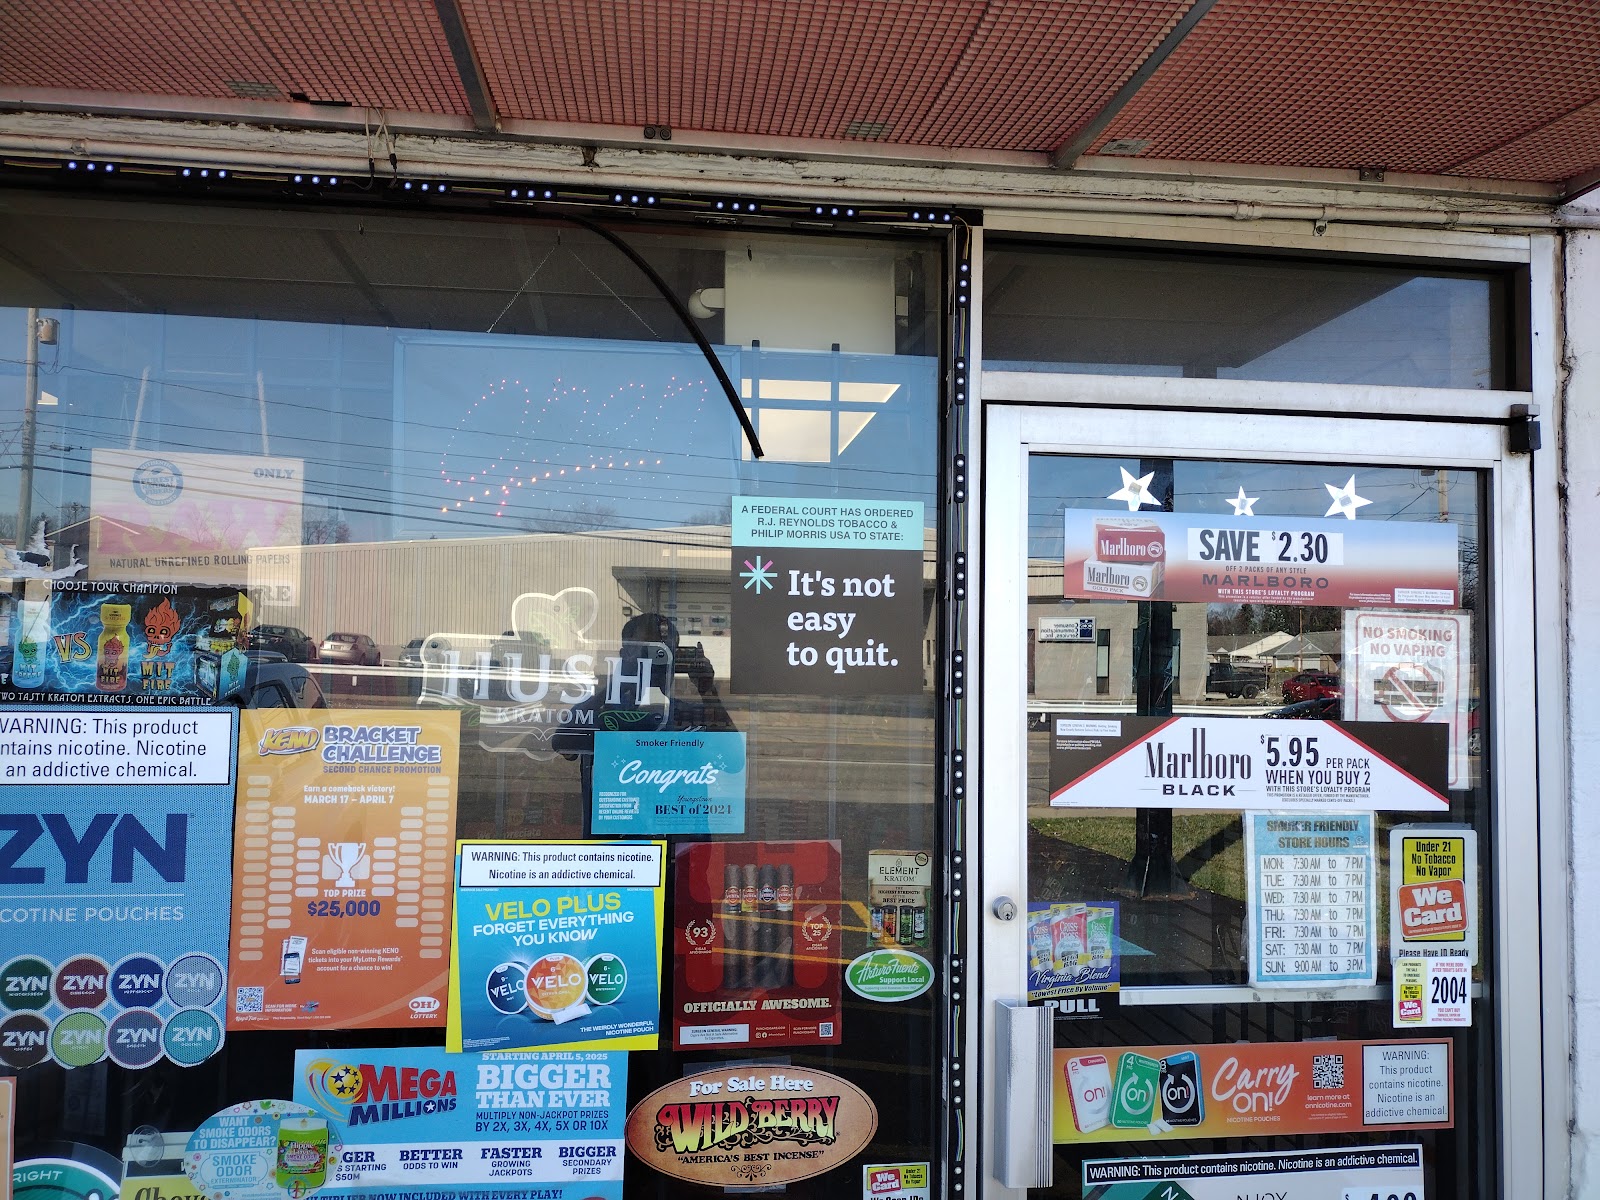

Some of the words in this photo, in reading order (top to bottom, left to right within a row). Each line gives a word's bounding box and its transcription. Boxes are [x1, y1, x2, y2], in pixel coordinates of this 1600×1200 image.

[254, 468, 295, 479] ONLY
[751, 506, 799, 514] FEDERAL
[802, 507, 837, 515] COURT
[864, 509, 913, 518] ORDERED
[779, 518, 835, 527] REYNOLDS
[838, 520, 888, 528] TOBACCO
[751, 530, 784, 538] PHILIP
[787, 530, 827, 539] MORRIS
[870, 532, 904, 540] STATE:
[1100, 538, 1146, 556] Marlboro
[1200, 530, 1260, 561] SAVE
[1272, 531, 1328, 563] $2.30
[110, 558, 151, 568] NATURAL
[155, 556, 209, 566] UNREFINED
[214, 555, 252, 565] ROLLING
[256, 554, 290, 564] PAPERS
[1087, 567, 1129, 585] Marlboro
[1203, 574, 1328, 588] MARLBORO
[43, 580, 88, 591] CHOOSE
[91, 582, 119, 592] YOUR
[123, 583, 177, 594] CHAMPION
[788, 570, 835, 596] It's
[843, 574, 895, 597] not
[787, 611, 856, 639] easy
[1363, 627, 1383, 638] NO
[1388, 628, 1452, 641] SMOKING
[54, 633, 92, 663] VS
[1370, 643, 1390, 654] NO
[1394, 644, 1445, 657] VAPING
[787, 642, 818, 666] to
[826, 639, 898, 674] quit.
[441, 650, 652, 705] HUSH
[18, 692, 45, 701] TASTY
[48, 693, 85, 702] KRATOM
[180, 697, 211, 705] BATTLE
[497, 708, 593, 724] KRATOM
[93, 718, 127, 734] This
[133, 719, 198, 737] product
[260, 728, 319, 754] KENO
[323, 726, 421, 745] BRACKET
[636, 739, 667, 747] Smoker
[670, 739, 704, 748] Friendly
[58, 741, 130, 755] nicotine.
[137, 741, 206, 755] Nicotine
[322, 745, 441, 763] CHALLENGE
[1145, 728, 1251, 780] Marlboro
[1260, 736, 1319, 767] $5.95
[1347, 758, 1370, 769] PACK
[32, 762, 109, 777] addictive
[116, 762, 197, 777] chemical.
[394, 766, 441, 774] PROMOTION
[619, 760, 719, 793] Congrats
[1266, 770, 1303, 784] WHEN
[1309, 771, 1333, 784] YOU
[1337, 771, 1361, 784] BUY
[1162, 784, 1235, 796] BLACK
[304, 795, 337, 804] MARCH
[360, 795, 386, 804] APRIL
[656, 805, 686, 814] BEST
[703, 805, 732, 814] 2024
[1314, 820, 1359, 831] FRIENDLY
[0, 813, 188, 885] ZYN
[1279, 837, 1312, 848] STORE
[1315, 837, 1349, 848] HOURS
[1416, 841, 1440, 852] Under
[472, 852, 520, 862] WARNING:
[543, 853, 576, 863] product
[578, 853, 615, 862] contains
[1264, 858, 1284, 870] MON:
[1294, 858, 1308, 869] 7:30
[1310, 858, 1320, 869] AM
[1352, 857, 1363, 868] PM
[1424, 854, 1456, 864] Tobacco
[552, 870, 591, 879] addictive
[593, 870, 635, 879] chemical.
[880, 867, 919, 875] ELEMENT
[1429, 866, 1451, 878] Vapor
[1264, 875, 1284, 886] TUE:
[324, 889, 339, 897] TOP
[342, 889, 365, 897] PRIZE
[1412, 887, 1452, 907] We
[85, 907, 184, 921] POUCHES
[307, 900, 380, 918] $25,000
[486, 899, 550, 921] VELO
[558, 893, 621, 914] PLUS
[1404, 903, 1462, 927] Card
[473, 920, 535, 936] FORGET
[539, 912, 634, 931] EVERYTHING
[513, 934, 544, 946] YOU
[549, 928, 597, 943] KNOW
[693, 927, 708, 937] 93
[857, 953, 892, 983] Arturo
[891, 959, 919, 974] Fuente
[1266, 961, 1285, 973] SUN:
[1295, 961, 1309, 972] 9:00
[119, 974, 161, 990] ZYN
[531, 974, 582, 989] VELO
[1029, 969, 1072, 989] Virginia
[1075, 967, 1111, 984] Blend
[1432, 977, 1467, 1003] 2004
[684, 1000, 757, 1013] OFFICIALLY
[761, 998, 832, 1010] AWESOME.
[1044, 999, 1100, 1013] PULL
[618, 1021, 654, 1030] WONDERFUL
[1382, 1050, 1429, 1060] WARNING:
[353, 1064, 457, 1104] MEGA
[476, 1064, 611, 1090] BIGGER
[1212, 1057, 1299, 1105] Carry
[689, 1080, 723, 1097] For
[727, 1076, 765, 1093] Sale
[770, 1075, 814, 1091] Here
[476, 1091, 545, 1108] THAN
[548, 1090, 610, 1107] EVER
[1305, 1101, 1352, 1109] onnicotine.com
[348, 1098, 457, 1126] MILLIONS
[519, 1111, 578, 1119] NON-JACKPOT
[1407, 1106, 1447, 1116] chemical.
[220, 1117, 249, 1127] WANT
[656, 1101, 751, 1153] WILD
[751, 1096, 840, 1140] BERRY
[200, 1128, 235, 1138] SMOKE
[238, 1127, 271, 1137] ODORS
[210, 1136, 276, 1149] DISAPPEAR?
[400, 1149, 462, 1161] BETTER
[481, 1148, 542, 1159] FASTER
[559, 1146, 616, 1157] BIGGER
[743, 1153, 770, 1161] BEST
[1090, 1166, 1140, 1179] WARNING:
[1164, 1164, 1199, 1177] product
[1279, 1158, 1313, 1170] Nicotine
[1338, 1154, 1375, 1166] addictive
[1377, 1152, 1417, 1164] chemical.
